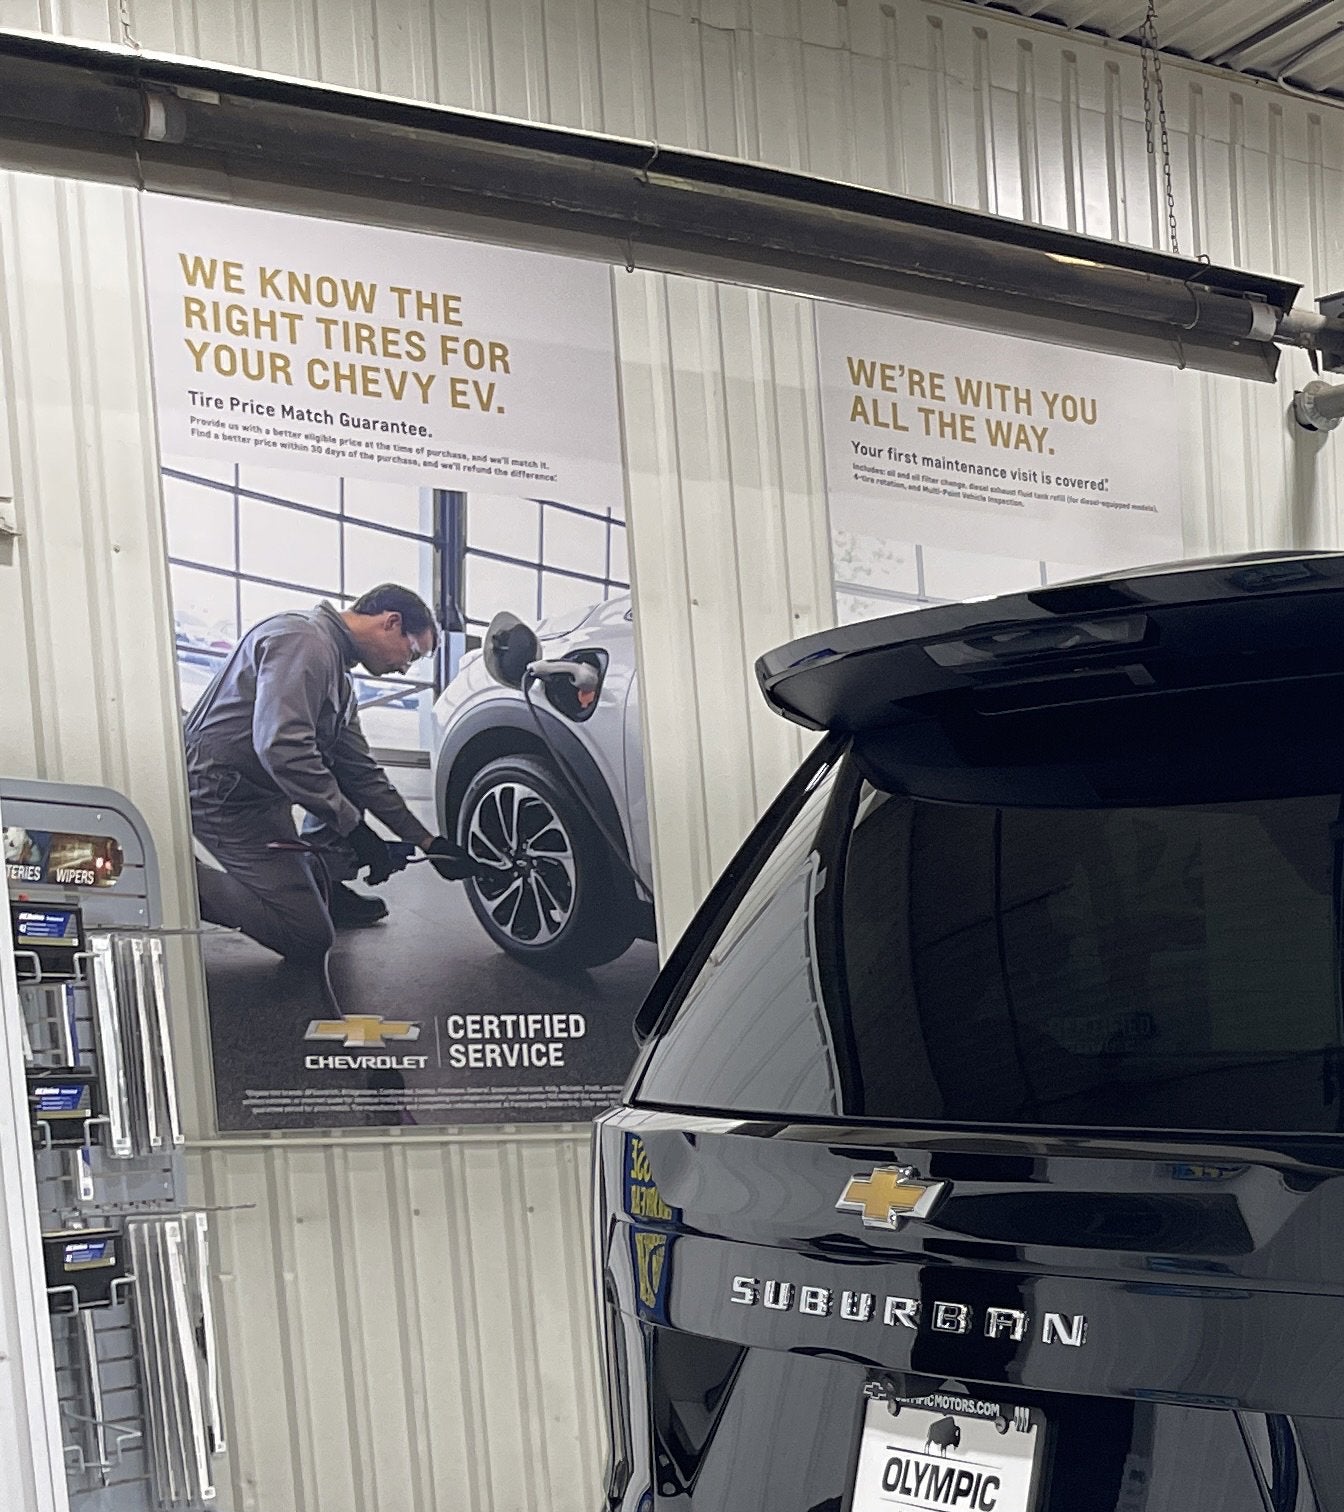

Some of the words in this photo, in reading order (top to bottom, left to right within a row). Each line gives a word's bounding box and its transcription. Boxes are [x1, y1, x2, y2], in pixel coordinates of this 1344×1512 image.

[179, 253, 246, 295] WE
[258, 266, 377, 315] KNOW
[389, 286, 464, 328] THE
[183, 296, 304, 346] RIGHT
[315, 316, 428, 363] TIRES
[440, 334, 512, 375] FOR
[184, 338, 294, 387] YOUR
[306, 357, 437, 404] CHEVY
[449, 377, 506, 415] EV.
[955, 376, 1034, 418] WITH
[1040, 391, 1098, 427] YOU
[188, 390, 224, 410] Tire
[230, 396, 275, 417] Price
[281, 403, 334, 426] Match
[339, 412, 434, 440] Guarantee.
[190, 415, 226, 429] Provide
[228, 423, 239, 431] us
[242, 423, 262, 435] with
[264, 427, 271, 436] a
[272, 428, 302, 440] better
[339, 437, 363, 448] price
[364, 440, 375, 450] at
[376, 442, 391, 452] the
[850, 395, 910, 433] ALL
[917, 406, 978, 445] THE
[985, 418, 1056, 456] WAY.
[222, 432, 251, 445] better
[253, 437, 278, 449] price
[280, 441, 309, 452] within
[325, 446, 346, 459] days
[851, 440, 884, 459] Your
[887, 447, 918, 466] first
[921, 454, 1007, 480] maintenance
[1010, 468, 1038, 484] visit
[1041, 470, 1052, 486] is
[56, 868, 95, 885] WIPERS
[446, 1013, 587, 1040] CERTIFIED
[304, 1054, 430, 1070] CHEVROLET
[448, 1042, 566, 1069] SERVICE
[730, 1274, 1088, 1348] SUBURBAN
[881, 1456, 1001, 1512] OLYMPIC
